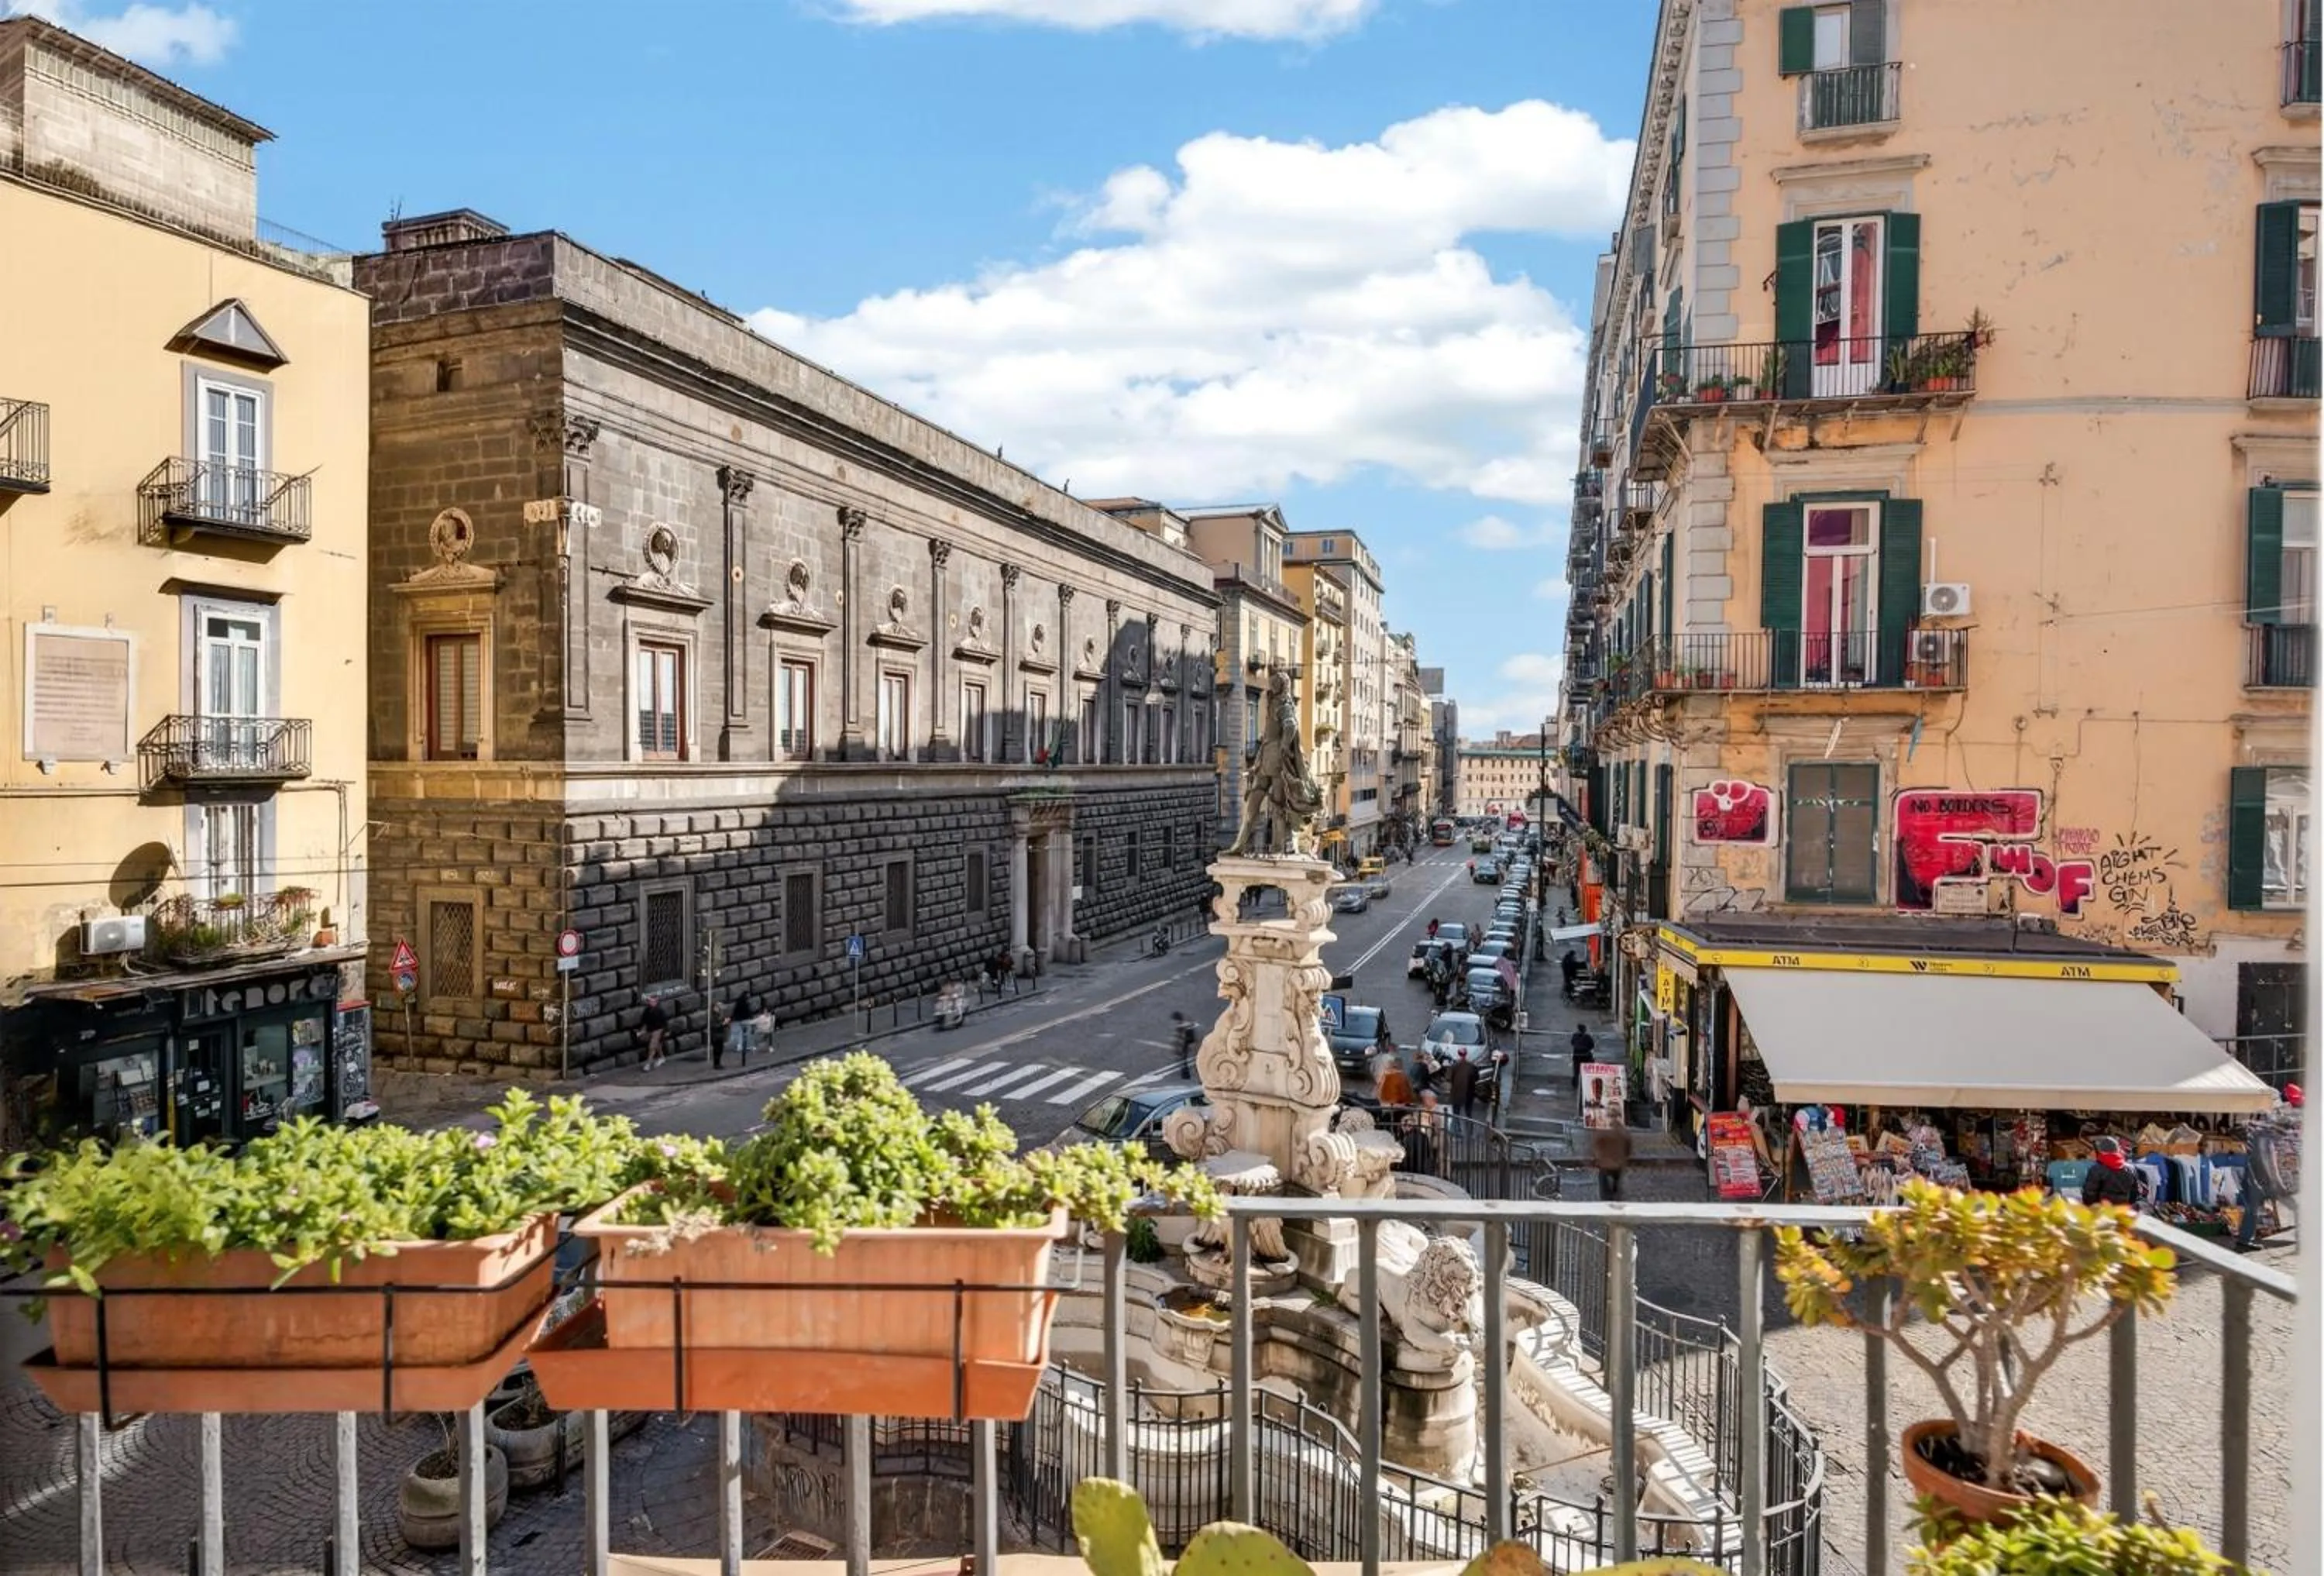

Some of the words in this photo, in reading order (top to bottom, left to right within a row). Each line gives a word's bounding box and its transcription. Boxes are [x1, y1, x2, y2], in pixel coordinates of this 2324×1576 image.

[1910, 799, 1931, 813] NO
[1772, 955, 1800, 966] ATM
[2061, 966, 2091, 979] ATM
